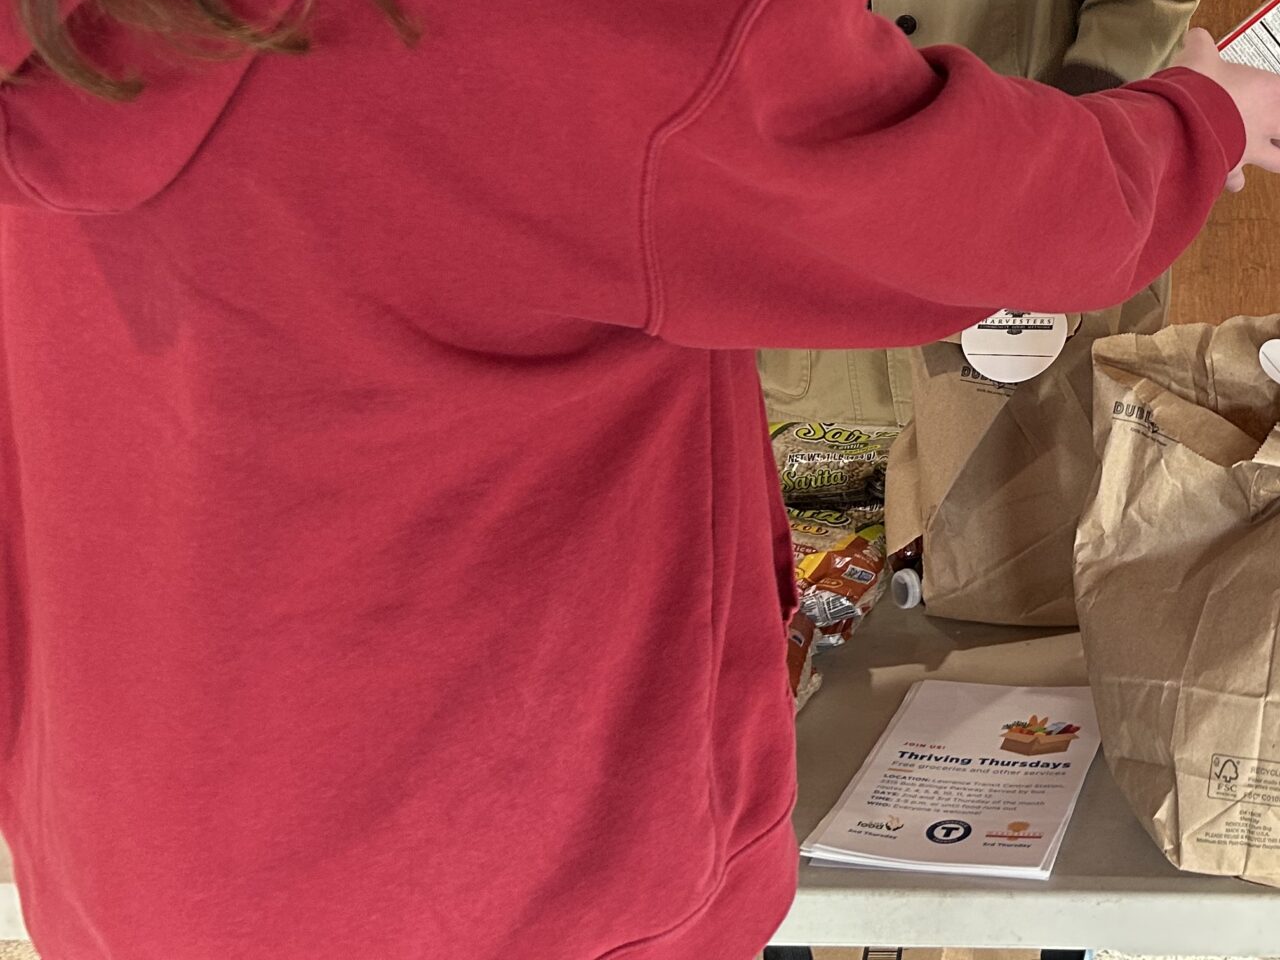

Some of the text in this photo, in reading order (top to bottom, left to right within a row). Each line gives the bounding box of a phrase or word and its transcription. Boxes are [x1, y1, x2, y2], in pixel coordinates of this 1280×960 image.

[782, 469, 848, 492] Sarita
[898, 750, 1071, 769] Thriving Thursdays
[891, 760, 915, 769] Free
[918, 763, 968, 773] groceries
[883, 773, 932, 782] LOCATION:
[1217, 783, 1237, 792] FSC
[893, 804, 931, 812] Everyone
[941, 827, 960, 837] T
